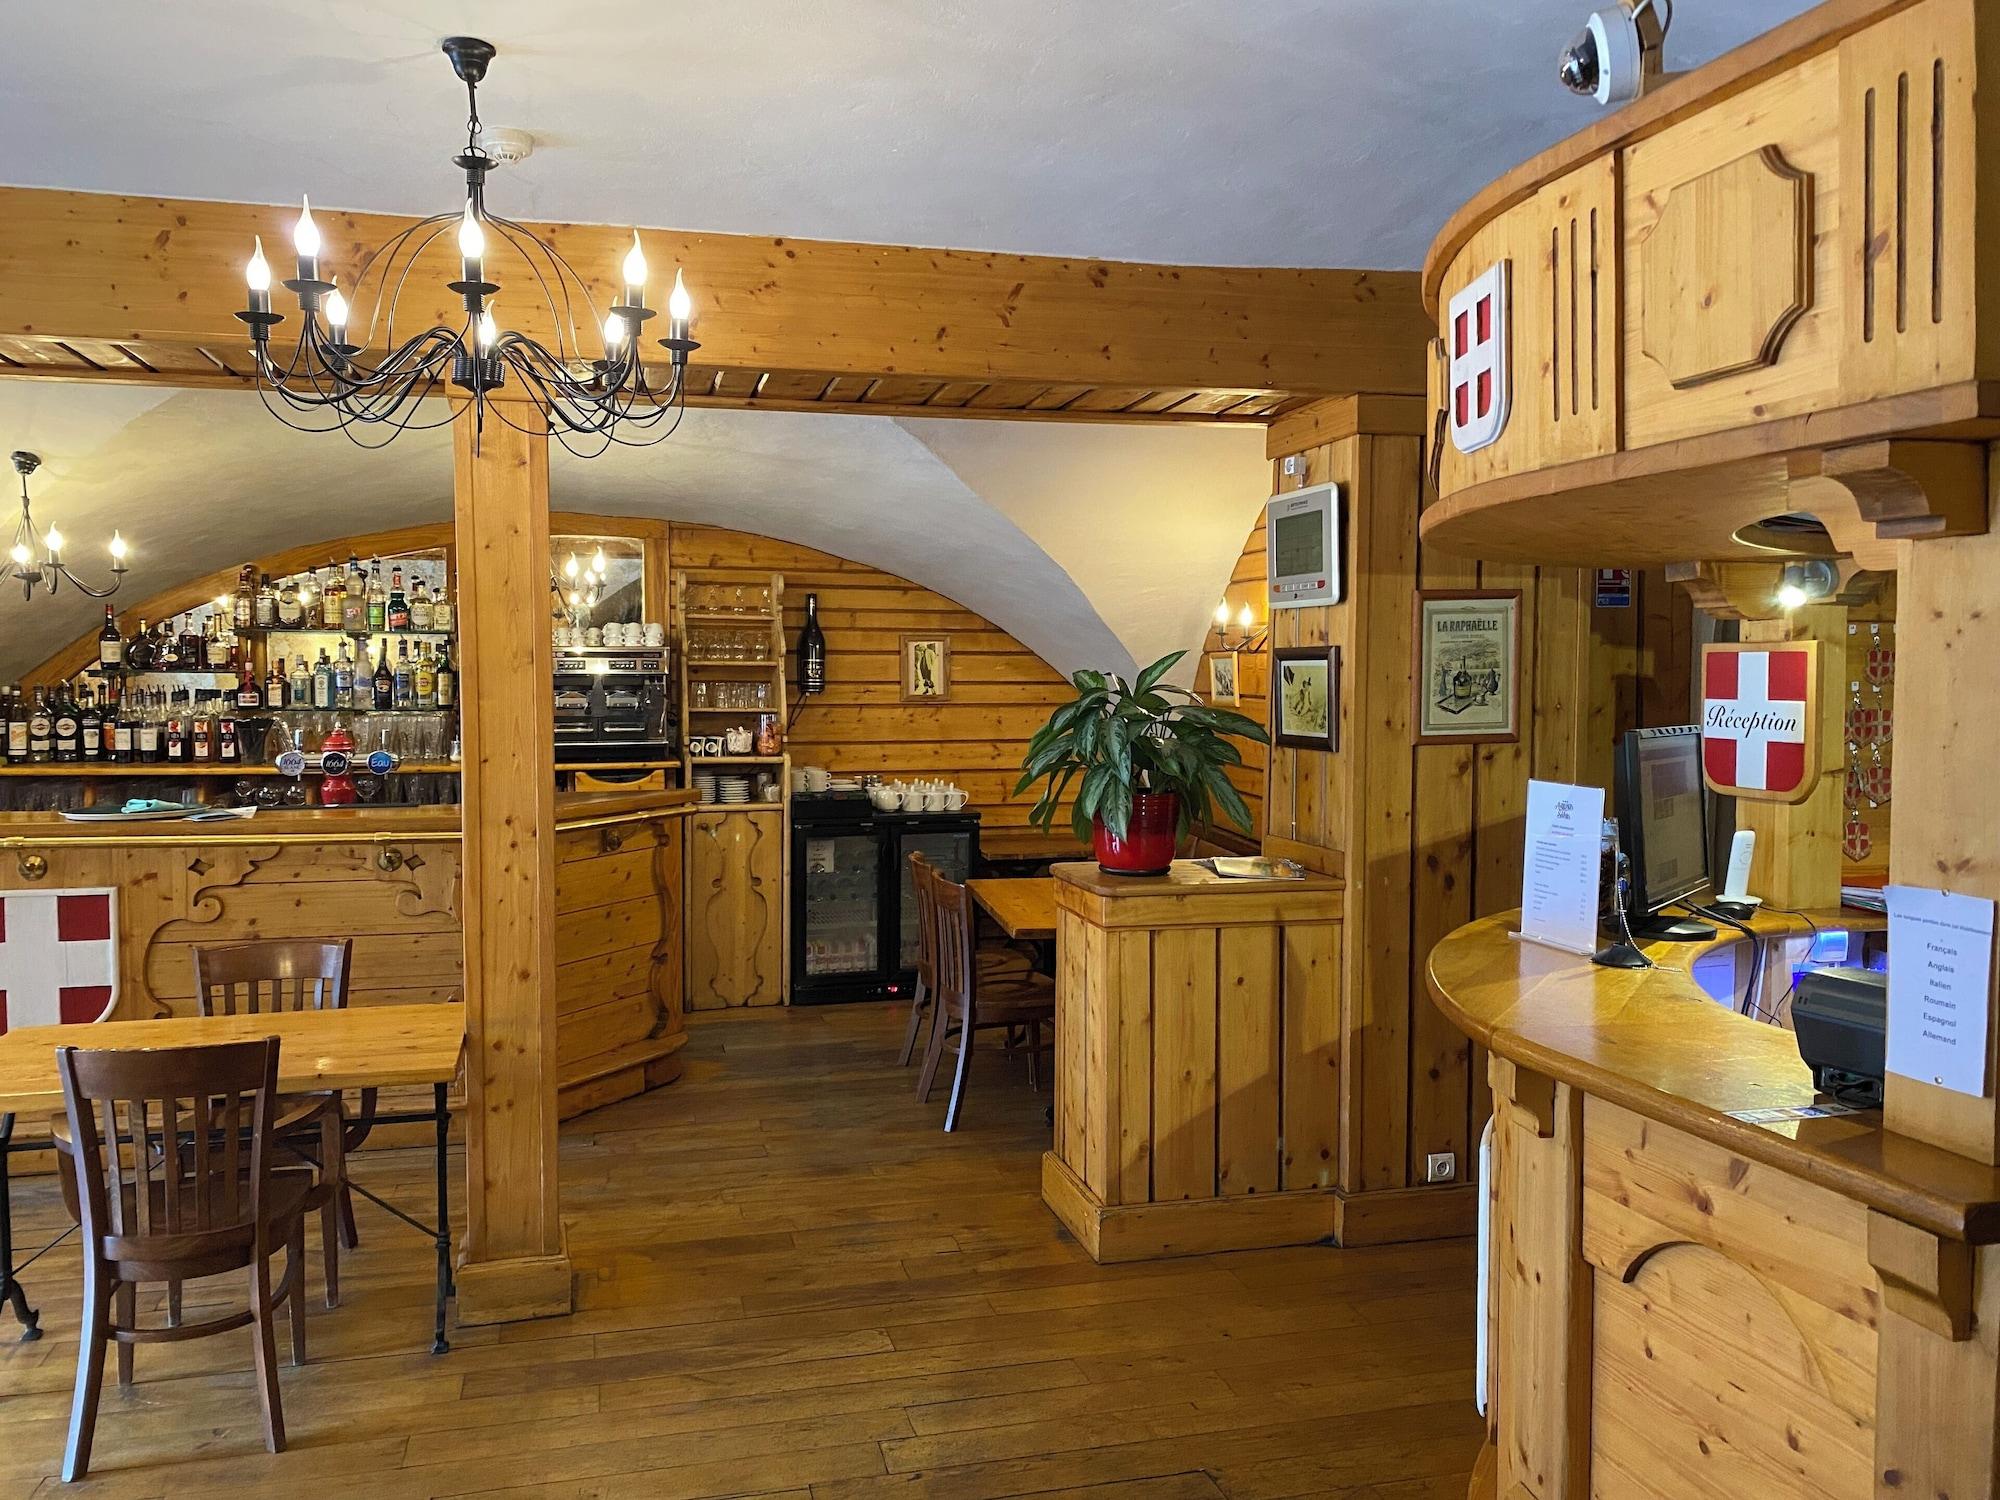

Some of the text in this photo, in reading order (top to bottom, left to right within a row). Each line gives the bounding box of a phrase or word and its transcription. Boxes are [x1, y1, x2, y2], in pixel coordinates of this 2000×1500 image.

[1437, 621, 1448, 632] LA
[1706, 704, 1797, 738] Réception
[325, 758, 345, 768] 1664
[371, 759, 389, 768] Eau
[1926, 942, 1958, 956] Français
[1927, 960, 1955, 973] Anglais
[1930, 978, 1952, 990] Italien
[1924, 995, 1957, 1010] Roumain
[1923, 1012, 1957, 1027] Espagnol
[1922, 1030, 1957, 1046] Allemand
